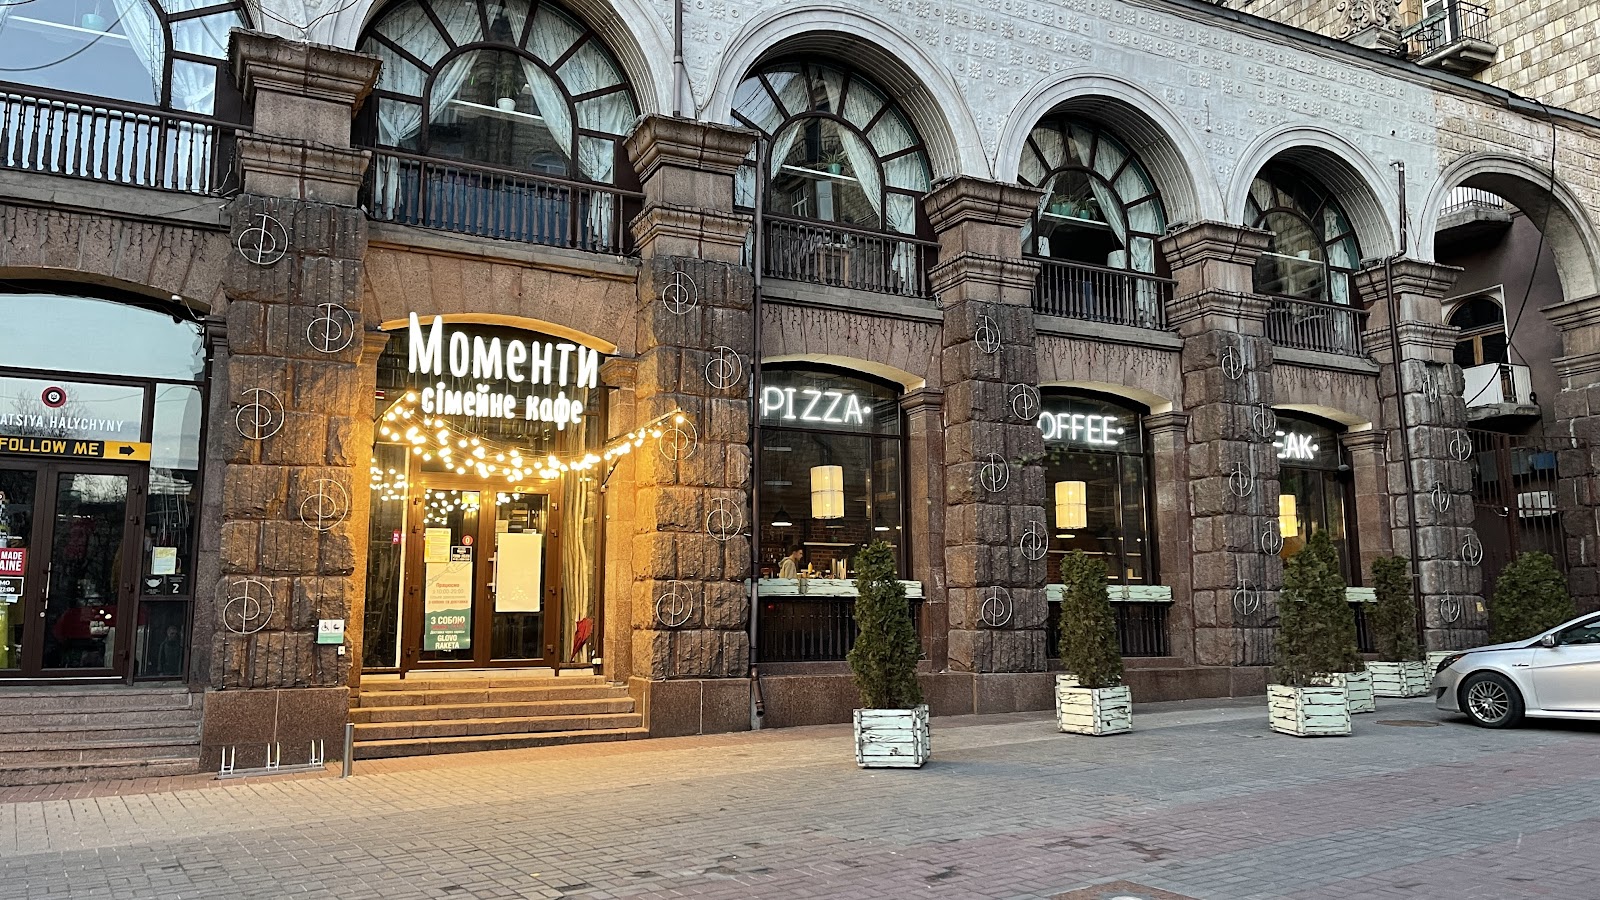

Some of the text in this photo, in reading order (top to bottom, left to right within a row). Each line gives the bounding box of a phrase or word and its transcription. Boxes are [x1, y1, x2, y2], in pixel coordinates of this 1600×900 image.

[408, 311, 598, 389] Моменти
[421, 382, 583, 431] сімейне кафе
[763, 386, 863, 424] PIZZA
[49, 416, 124, 433] HALYCHYNY
[0, 437, 100, 455] FOLLOW ME
[1, 551, 23, 560] MADE
[437, 616, 466, 625] СОБОЮ
[435, 641, 460, 650] RAKETA
[437, 634, 458, 642] GLOVO
